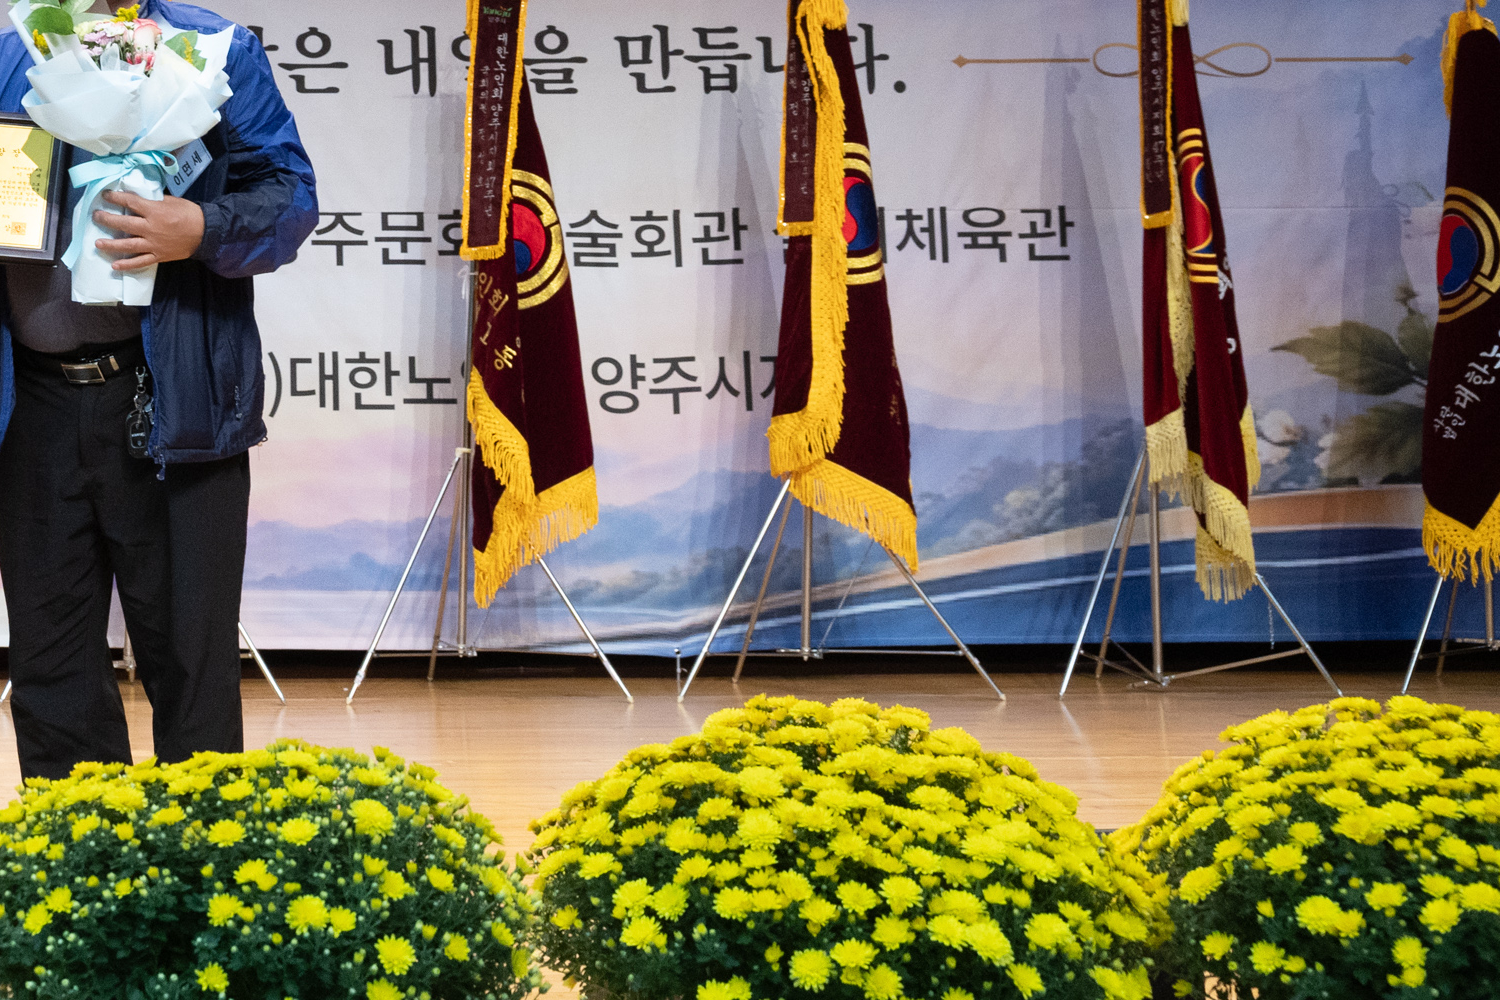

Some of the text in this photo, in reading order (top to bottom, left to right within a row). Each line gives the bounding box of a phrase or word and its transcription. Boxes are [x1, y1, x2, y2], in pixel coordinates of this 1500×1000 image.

[263, 25, 349, 95] 은
[173, 150, 203, 186] 이면세
[297, 206, 747, 270] 주문술회관
[267, 350, 468, 419] )대한노
[1454, 340, 1500, 409] 대한노
